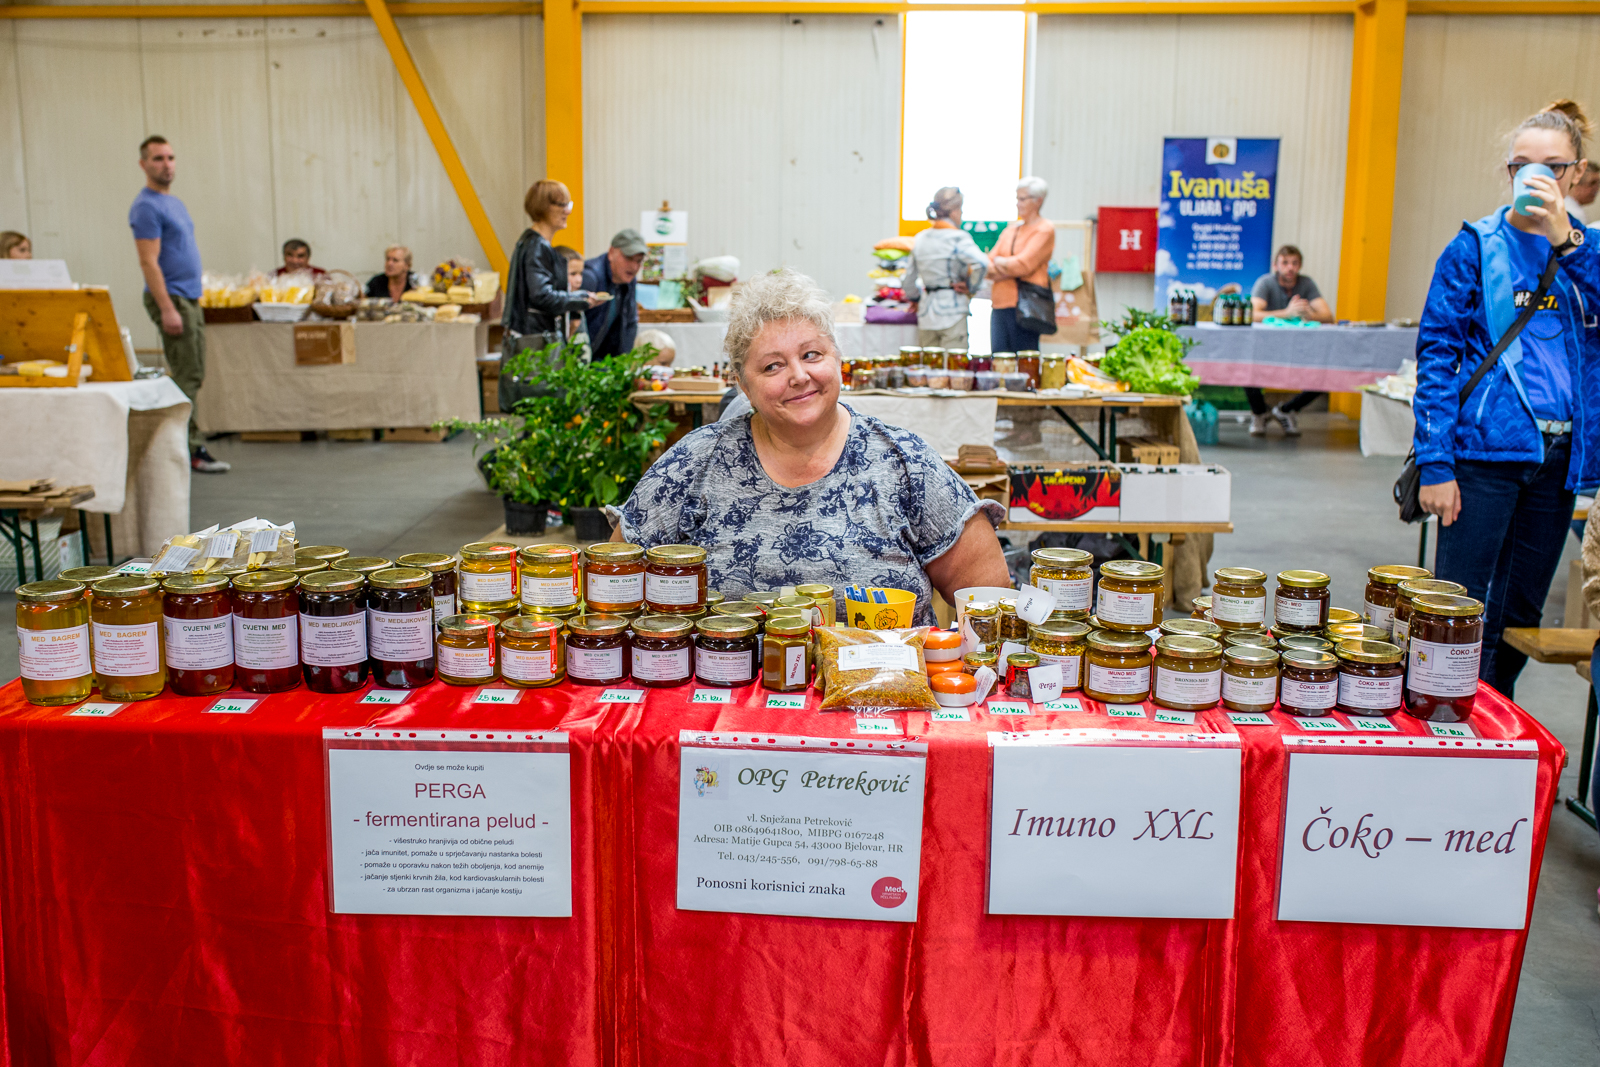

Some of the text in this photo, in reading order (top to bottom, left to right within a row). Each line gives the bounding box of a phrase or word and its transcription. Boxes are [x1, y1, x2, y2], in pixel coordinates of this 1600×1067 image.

[1168, 170, 1270, 199] Ivanuša
[1180, 200, 1222, 216] ULJARA
[1120, 229, 1142, 250] H
[322, 618, 362, 628] MEDLJIKOVAC
[52, 633, 80, 642] BAGREM
[415, 763, 435, 772] Ovdje
[737, 767, 911, 796] OPG Petreković
[415, 783, 486, 799] PERGA
[366, 811, 536, 831] fermentirana pelud
[747, 814, 853, 826] vl. Snježana Petreković
[1008, 807, 1215, 841] Imuno XXL
[714, 824, 884, 841] OIB 08649641800, MIBPG 0167248
[1302, 806, 1393, 859] Čoko
[1444, 816, 1528, 854] med
[428, 838, 458, 846] hranjivija
[491, 839, 514, 847] peludi
[694, 835, 903, 854] Adresa: Matije Gupca 54, 43000 Bjelovar, HR
[365, 849, 379, 857] jača
[411, 850, 438, 858] pomaže
[446, 850, 487, 859] sprječavanju
[718, 852, 878, 868] Tel. 043/245-556, 091/798-65-88
[364, 861, 390, 869] pomaže
[398, 862, 429, 870] oporavku
[364, 873, 388, 882] jačanje
[390, 874, 411, 882] stjenki
[475, 886, 499, 895] jačanje
[697, 877, 846, 895] Ponosni korisnici znaka
